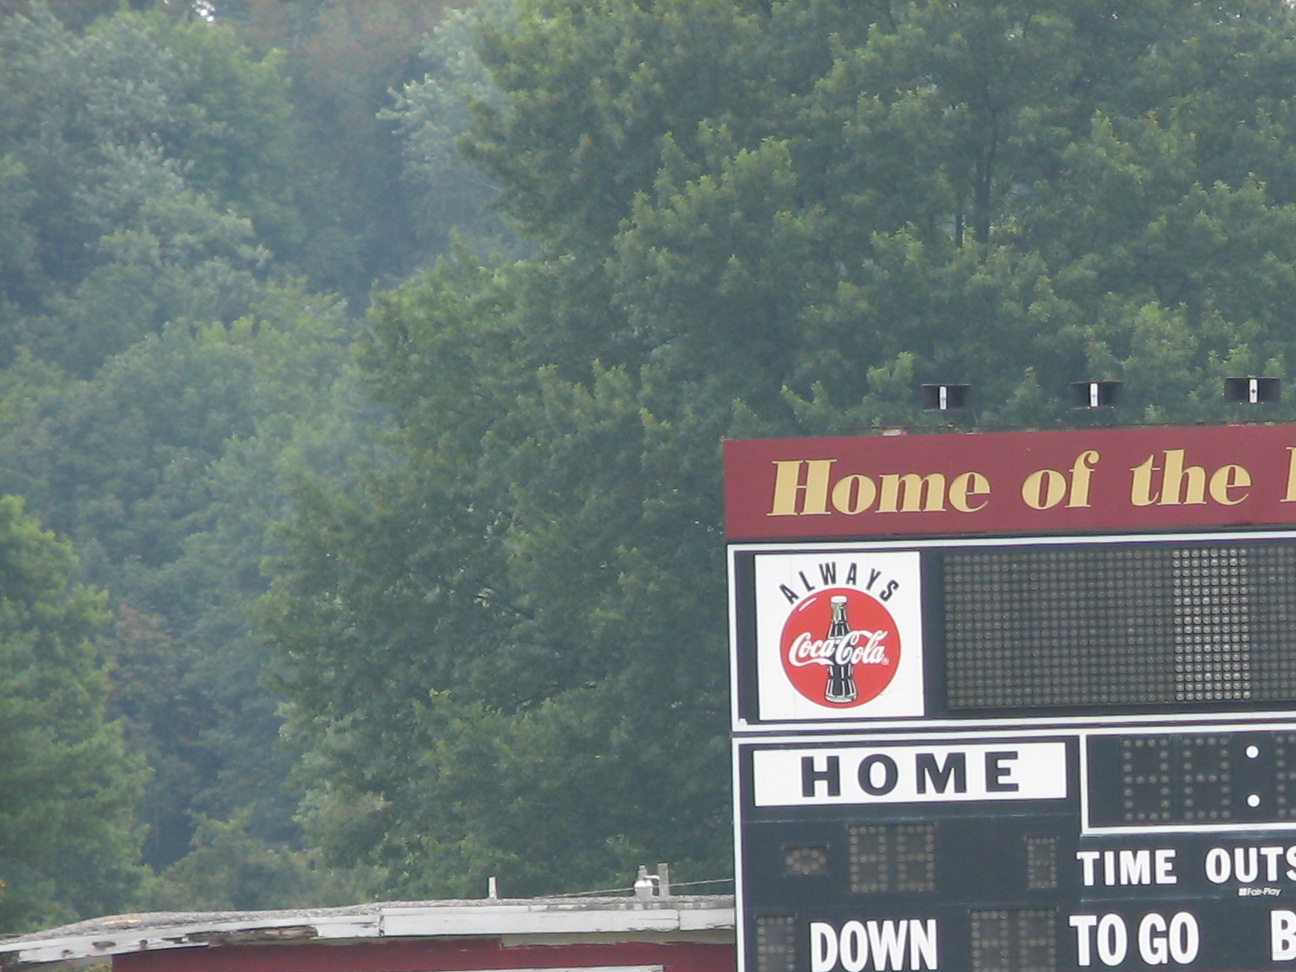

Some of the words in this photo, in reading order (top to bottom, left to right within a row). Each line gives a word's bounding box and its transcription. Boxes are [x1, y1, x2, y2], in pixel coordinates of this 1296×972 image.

[766, 458, 991, 516] Home
[1021, 449, 1100, 510] of
[1130, 448, 1253, 507] the
[779, 562, 899, 604] ALWAYS
[788, 630, 888, 667] Coca-Cola
[800, 751, 1020, 798] HOME
[1075, 849, 1177, 887] TIME
[1068, 913, 1128, 967] TO
[1138, 911, 1200, 965] GO
